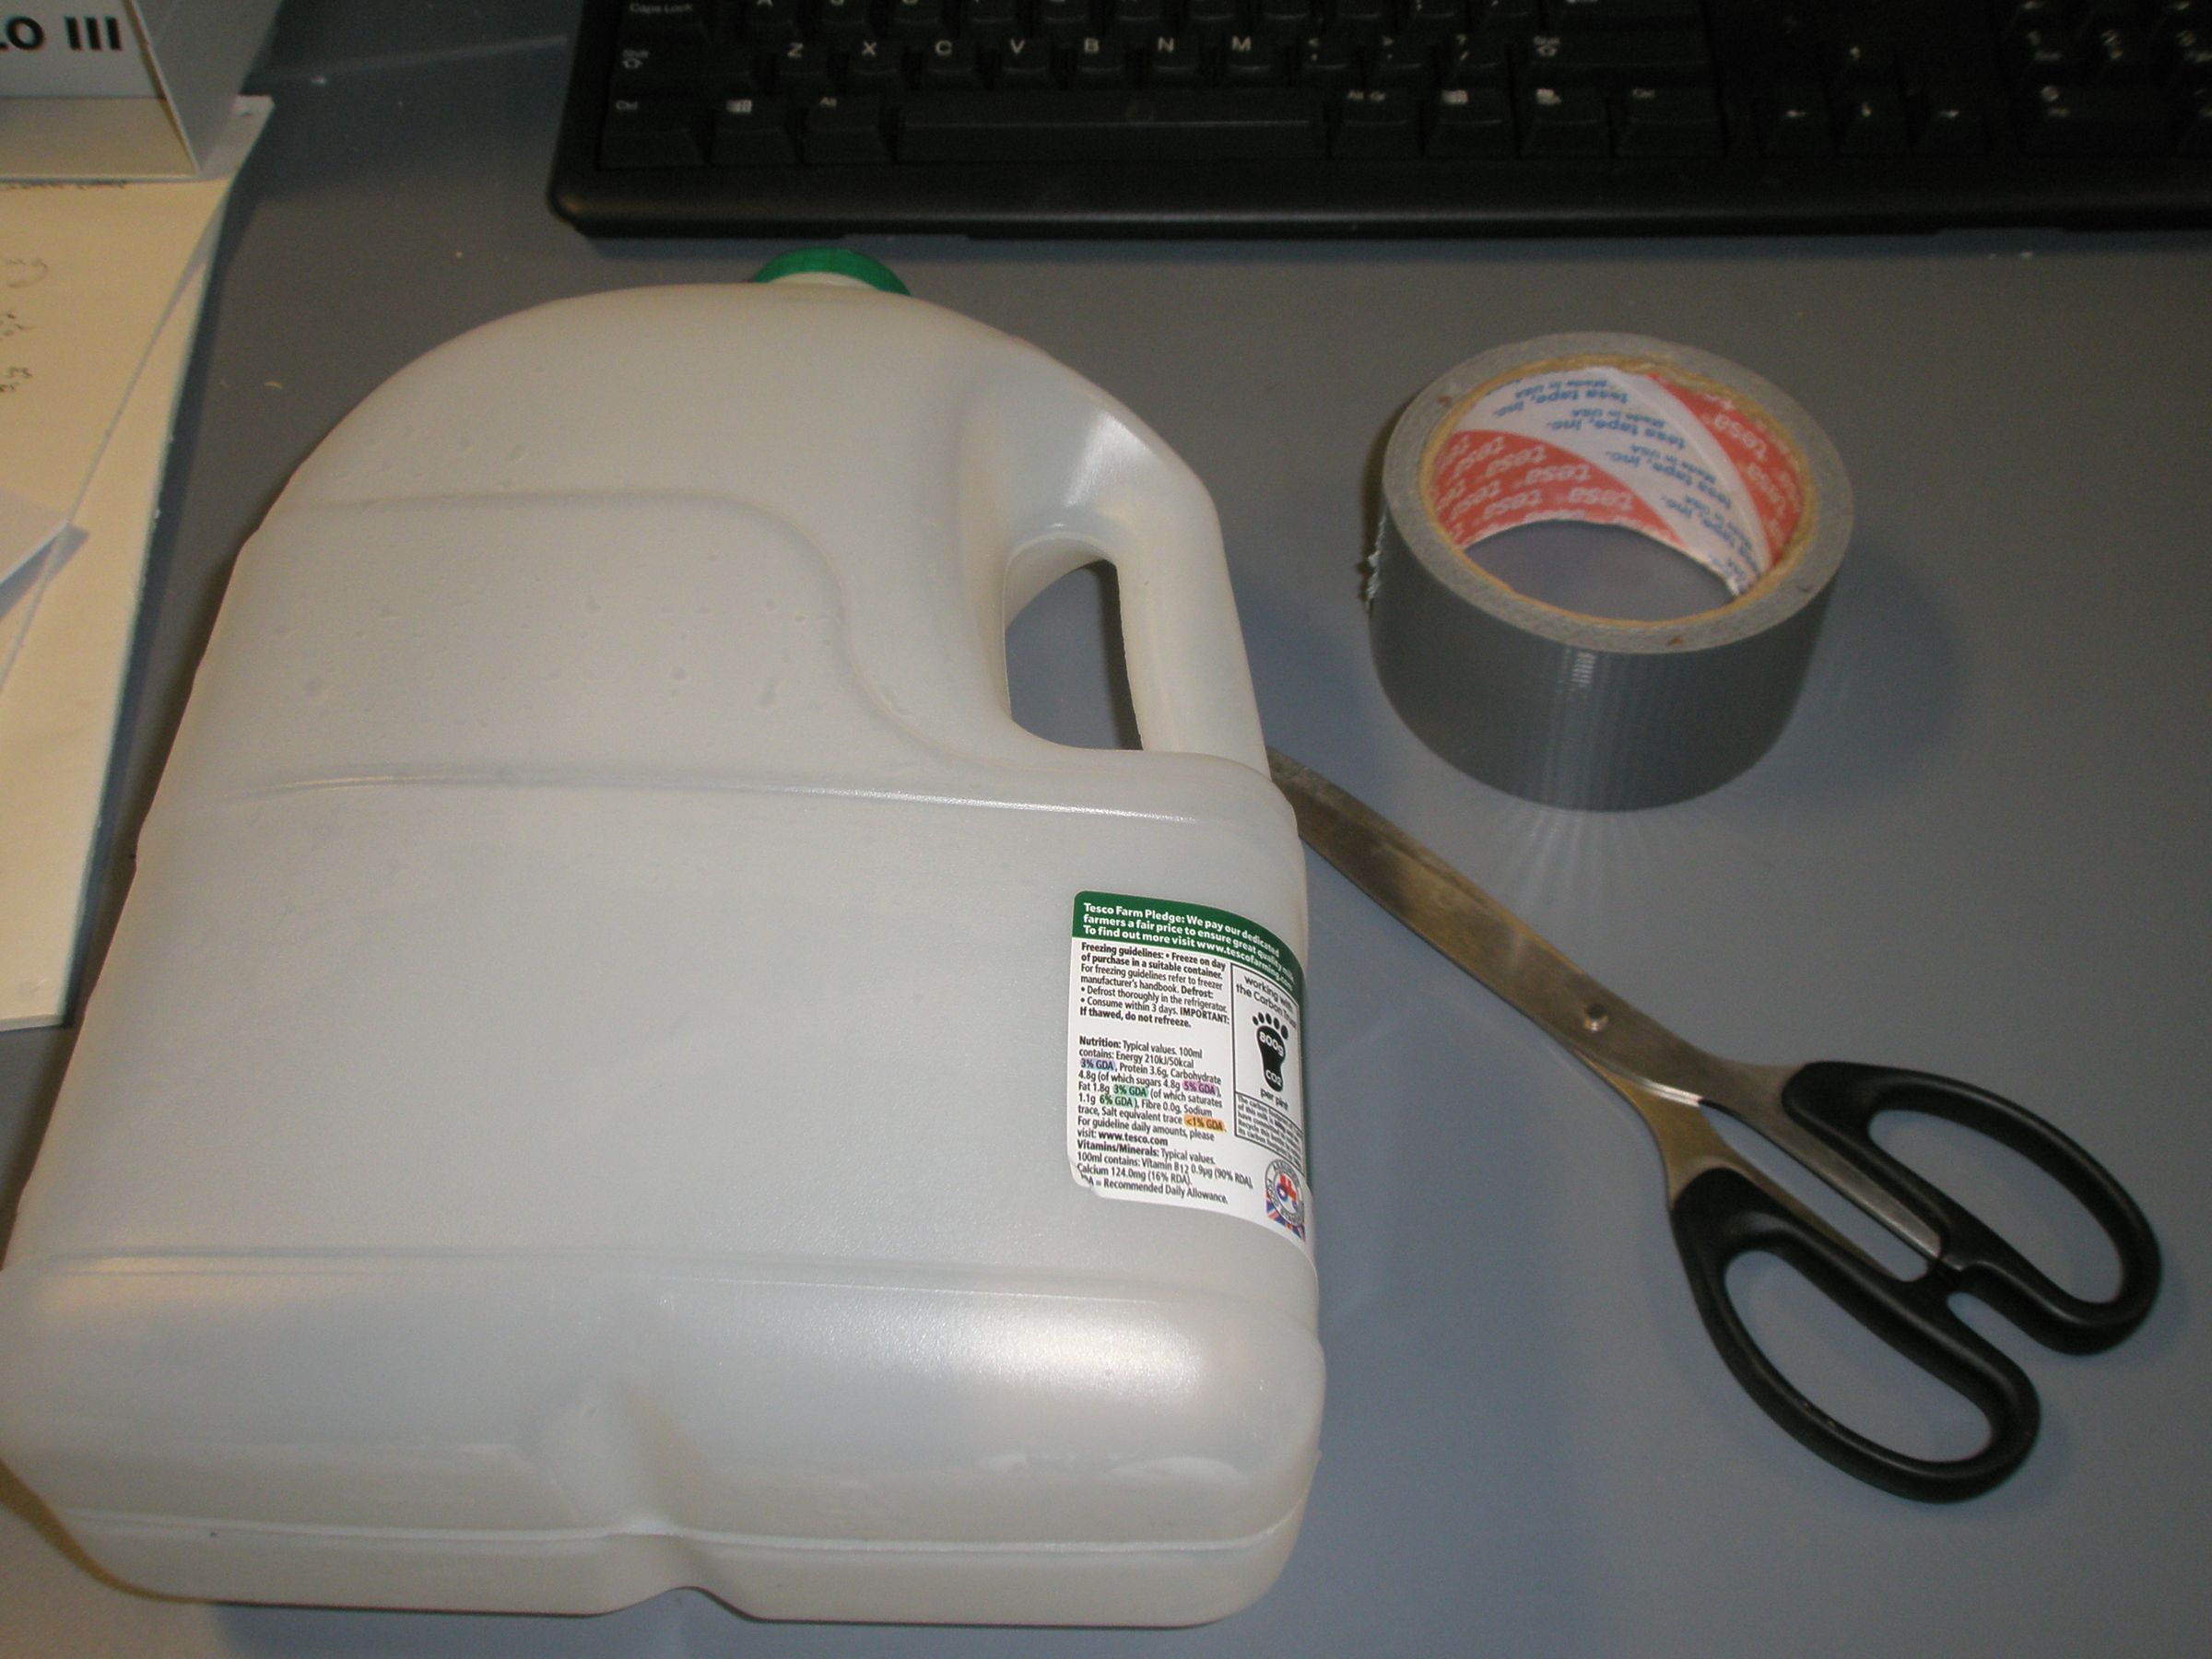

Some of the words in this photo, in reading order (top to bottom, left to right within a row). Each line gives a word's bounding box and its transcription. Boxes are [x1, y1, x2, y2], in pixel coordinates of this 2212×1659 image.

[0, 16, 44, 51] O
[1083, 37, 1100, 53] B
[1157, 36, 1175, 53] N
[1231, 36, 1252, 52] M
[787, 41, 804, 57] Z
[861, 41, 877, 56] X
[935, 40, 953, 55] C
[1009, 39, 1026, 53] V
[1566, 379, 1607, 388] Made
[1585, 389, 1629, 405] tesa
[1571, 407, 1604, 418] USA
[1625, 413, 1666, 429] Made
[1644, 428, 1686, 450] tesa
[1713, 412, 1767, 462] tesa
[1485, 445, 1546, 477] tesa
[1630, 444, 1661, 458] USA
[1524, 463, 1591, 485] tesa
[1681, 461, 1717, 485] Made
[1482, 488, 1541, 521] tesa
[1568, 486, 1633, 512] tesa
[1698, 480, 1731, 510] tesa
[1083, 902, 1114, 914] Tesco
[1115, 906, 1143, 918] Farm
[1145, 909, 1185, 924] Pledge:
[1186, 914, 1204, 926] We
[1205, 921, 1224, 932] pay
[1225, 924, 1241, 936] our
[1241, 930, 1280, 958] dedicated
[1083, 924, 1096, 935] To
[1098, 926, 1121, 938] find
[1122, 931, 1141, 940] out
[1142, 934, 1171, 944] more
[1171, 935, 1195, 947] visit
[1083, 914, 1126, 927] farmers
[1135, 919, 1155, 931] fair
[1156, 924, 1183, 935] price
[1184, 927, 1196, 936] to
[1197, 929, 1231, 944] ensure
[1232, 938, 1256, 955] great
[1257, 949, 1282, 971] quality
[1081, 942, 1117, 956] Freezing
[1118, 946, 1164, 959] guidelines:
[1171, 952, 1198, 964] Freeze
[1199, 958, 1210, 966] on
[1211, 959, 1226, 971] day
[1081, 953, 1090, 961] of
[1092, 955, 1130, 966] purchase
[1132, 957, 1140, 967] in
[1148, 960, 1182, 973] suitable
[1183, 965, 1223, 980] container.
[1080, 975, 1137, 989] manufacturer's
[1139, 980, 1179, 994] handbook.
[1181, 985, 1214, 999] Defrost:
[1081, 963, 1093, 972] For
[1095, 964, 1126, 978] freezing
[1127, 969, 1167, 981] guidelines
[1168, 974, 1186, 983] refer
[1188, 974, 1196, 984] to
[1197, 977, 1223, 990] freezer
[1087, 985, 1116, 996] Defrost
[1117, 989, 1159, 1004] thoroughly
[1161, 994, 1169, 1003] in
[1170, 994, 1182, 1005] the
[1183, 998, 1228, 1015] refrigerator.
[1235, 983, 1252, 997] the
[1253, 991, 1283, 1015] Carbon
[1244, 976, 1279, 1003] working
[1079, 1006, 1087, 1016] If
[1088, 1007, 1124, 1021] thawed,
[1124, 1011, 1136, 1020] do
[1137, 1013, 1153, 1023] not
[1154, 1016, 1192, 1028] refreeze.
[1087, 996, 1124, 1008] Consume
[1124, 1001, 1150, 1011] within
[1151, 1004, 1157, 1013] 3
[1159, 1005, 1178, 1017] days.
[1180, 1006, 1230, 1025] IMPORTANT:
[1079, 1035, 1122, 1049] Nutrition:
[1123, 1040, 1149, 1053] Typical
[1179, 1047, 1203, 1059] 100ml
[1259, 1030, 1284, 1057] 800g
[1078, 1049, 1114, 1059] contains:
[1115, 1051, 1143, 1065] Energy
[1145, 1053, 1194, 1068] 210kJ/50kcal
[1078, 1070, 1096, 1082] 4.8g
[1098, 1071, 1110, 1082] (of
[1111, 1073, 1135, 1085] which
[1135, 1077, 1161, 1088] sugars
[1162, 1079, 1181, 1092] 4.8g
[1183, 1080, 1197, 1091] 5%
[1081, 1058, 1094, 1069] 3%
[1119, 1062, 1148, 1075] Protein
[1171, 1068, 1222, 1086] Carbohydrate
[1078, 1081, 1090, 1091] Fat
[1093, 1083, 1111, 1095] 1.8g
[1112, 1084, 1127, 1095] 3%
[1128, 1086, 1147, 1097] GDA
[1150, 1088, 1162, 1100] (of
[1163, 1090, 1187, 1101] which
[1187, 1095, 1223, 1108] saturates
[1078, 1092, 1096, 1105] 1.1g
[1100, 1094, 1113, 1105] 6%
[1141, 1100, 1161, 1110] Fibre
[1183, 1104, 1213, 1117] Sodium
[1260, 1088, 1274, 1100] per
[1077, 1104, 1100, 1116] trace,
[1101, 1106, 1118, 1117] Salt
[1119, 1109, 1161, 1121] equivalent
[1162, 1114, 1182, 1124] trace
[1186, 1117, 1205, 1128] <1%
[1077, 1116, 1090, 1126] For
[1092, 1117, 1130, 1129] guideline
[1131, 1122, 1151, 1134] daily
[1152, 1124, 1188, 1138] amounts,
[1189, 1128, 1215, 1142] please
[1077, 1128, 1097, 1138] visit:
[1098, 1131, 1169, 1147] www.tesco.com
[1077, 1139, 1159, 1157] Vitamins/Minerals:
[1160, 1148, 1188, 1161] Typical
[1077, 1151, 1102, 1162] 100ml
[1103, 1153, 1141, 1167] contains:
[1141, 1158, 1172, 1171] Vitamin
[1173, 1161, 1189, 1174] B12
[1214, 1167, 1233, 1182] (90%
[1077, 1162, 1109, 1176] Calcium
[1112, 1167, 1147, 1181] 124.0mg
[1147, 1170, 1169, 1182] (16%
[1103, 1178, 1163, 1194] Recommended
[1165, 1184, 1185, 1198] Daily
[1186, 1187, 1229, 1205] Allowance.
